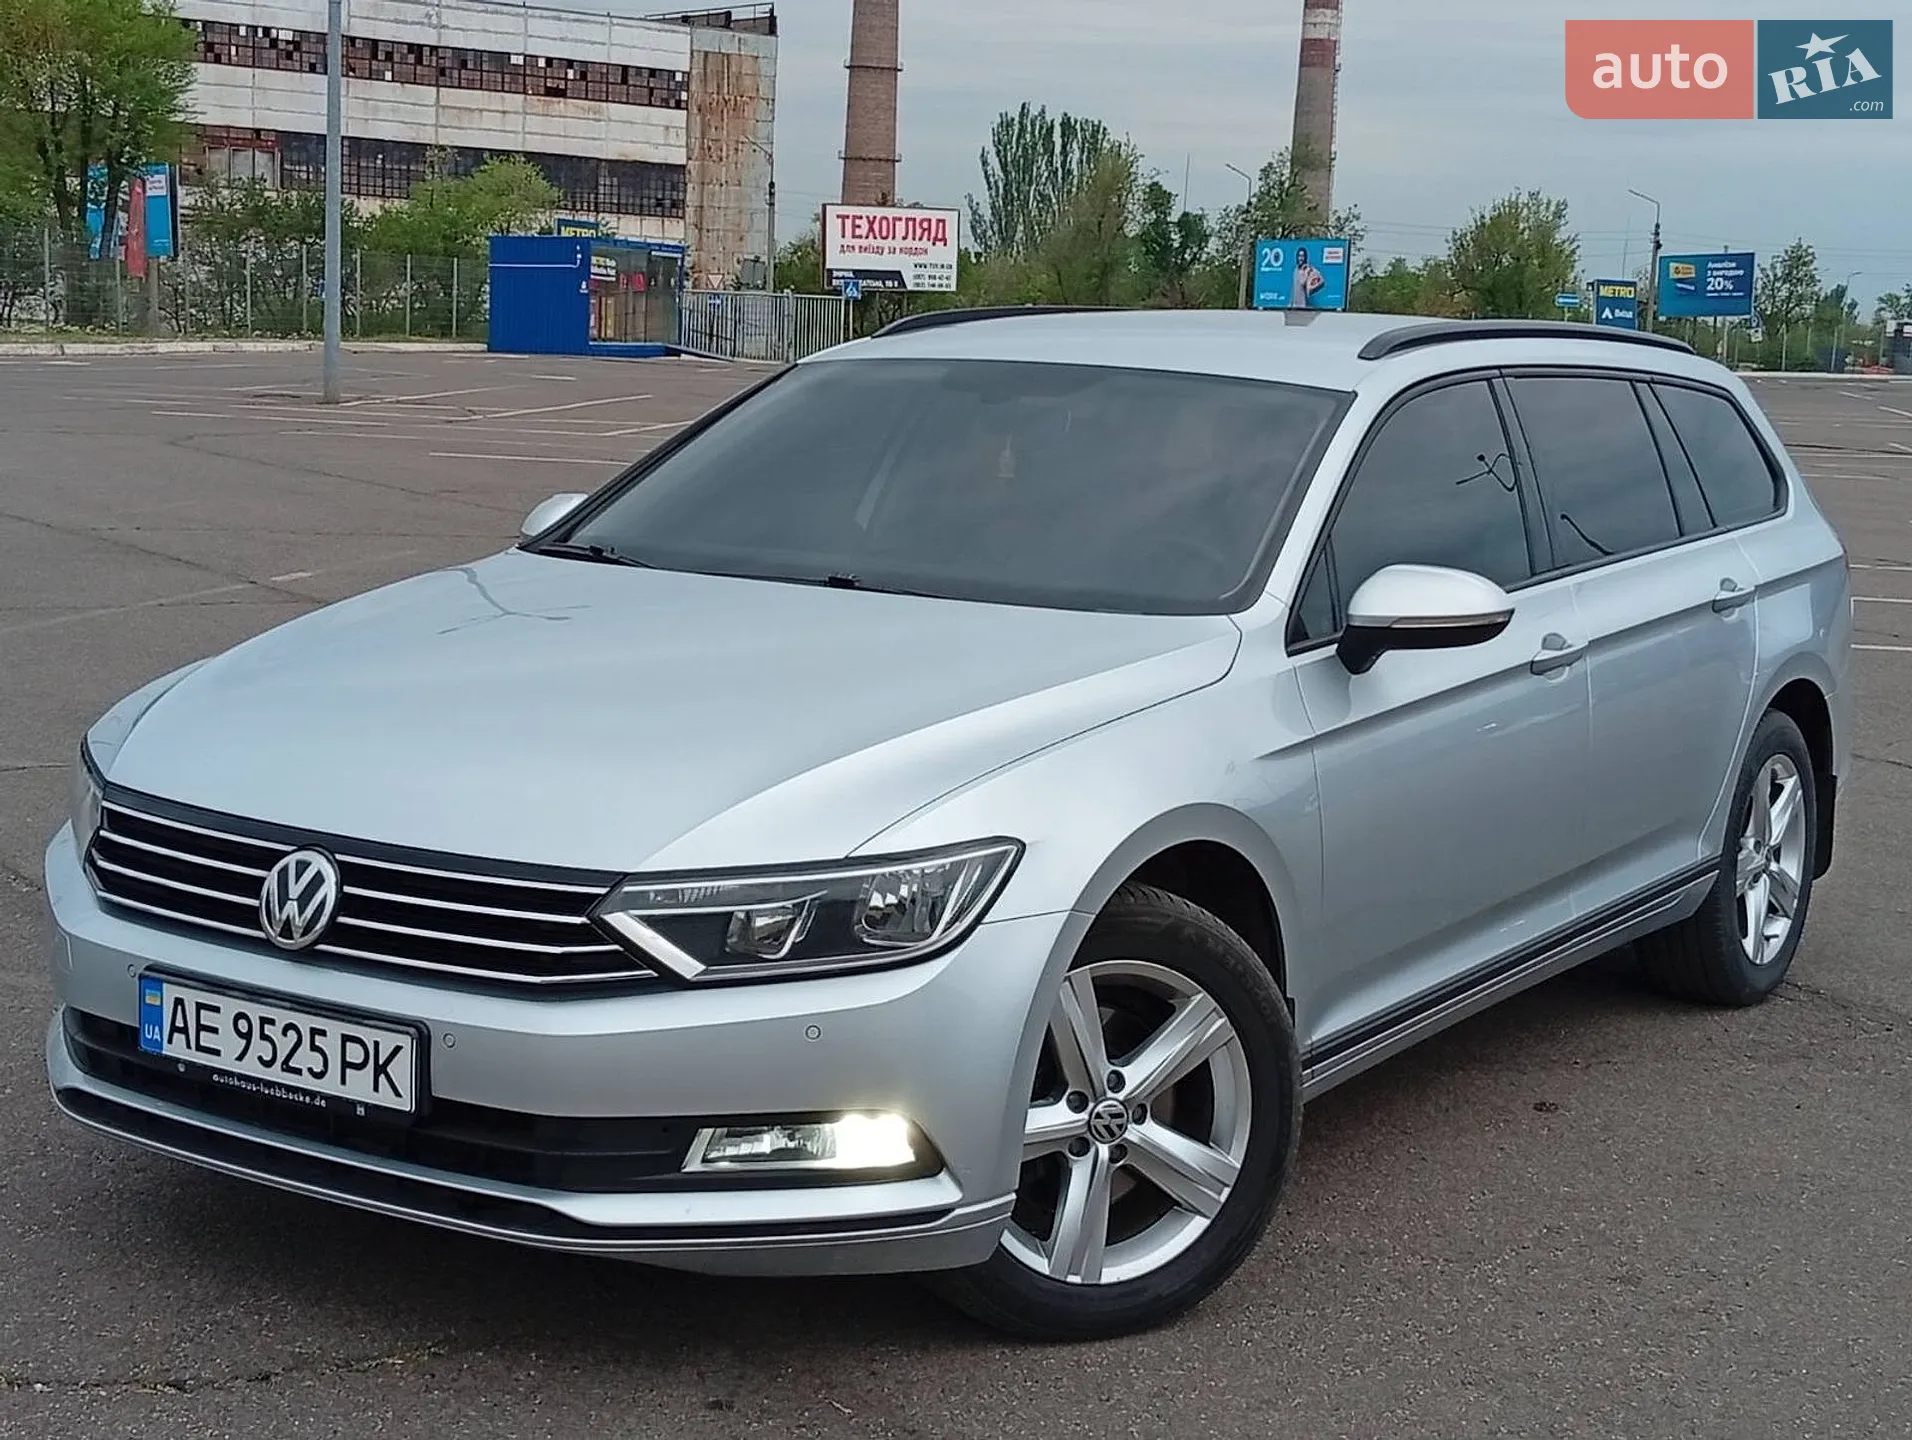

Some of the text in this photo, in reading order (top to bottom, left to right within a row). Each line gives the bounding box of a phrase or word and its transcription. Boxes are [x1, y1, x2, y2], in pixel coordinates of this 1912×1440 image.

[561, 226, 597, 238] METRO
[836, 214, 948, 247] ТЕХОГЛЯД
[1261, 247, 1284, 267] 20
[1599, 285, 1635, 298] METRO
[1706, 277, 1734, 291] 20%
[144, 1025, 162, 1042] UA
[167, 997, 405, 1099] AE 9525 PK
